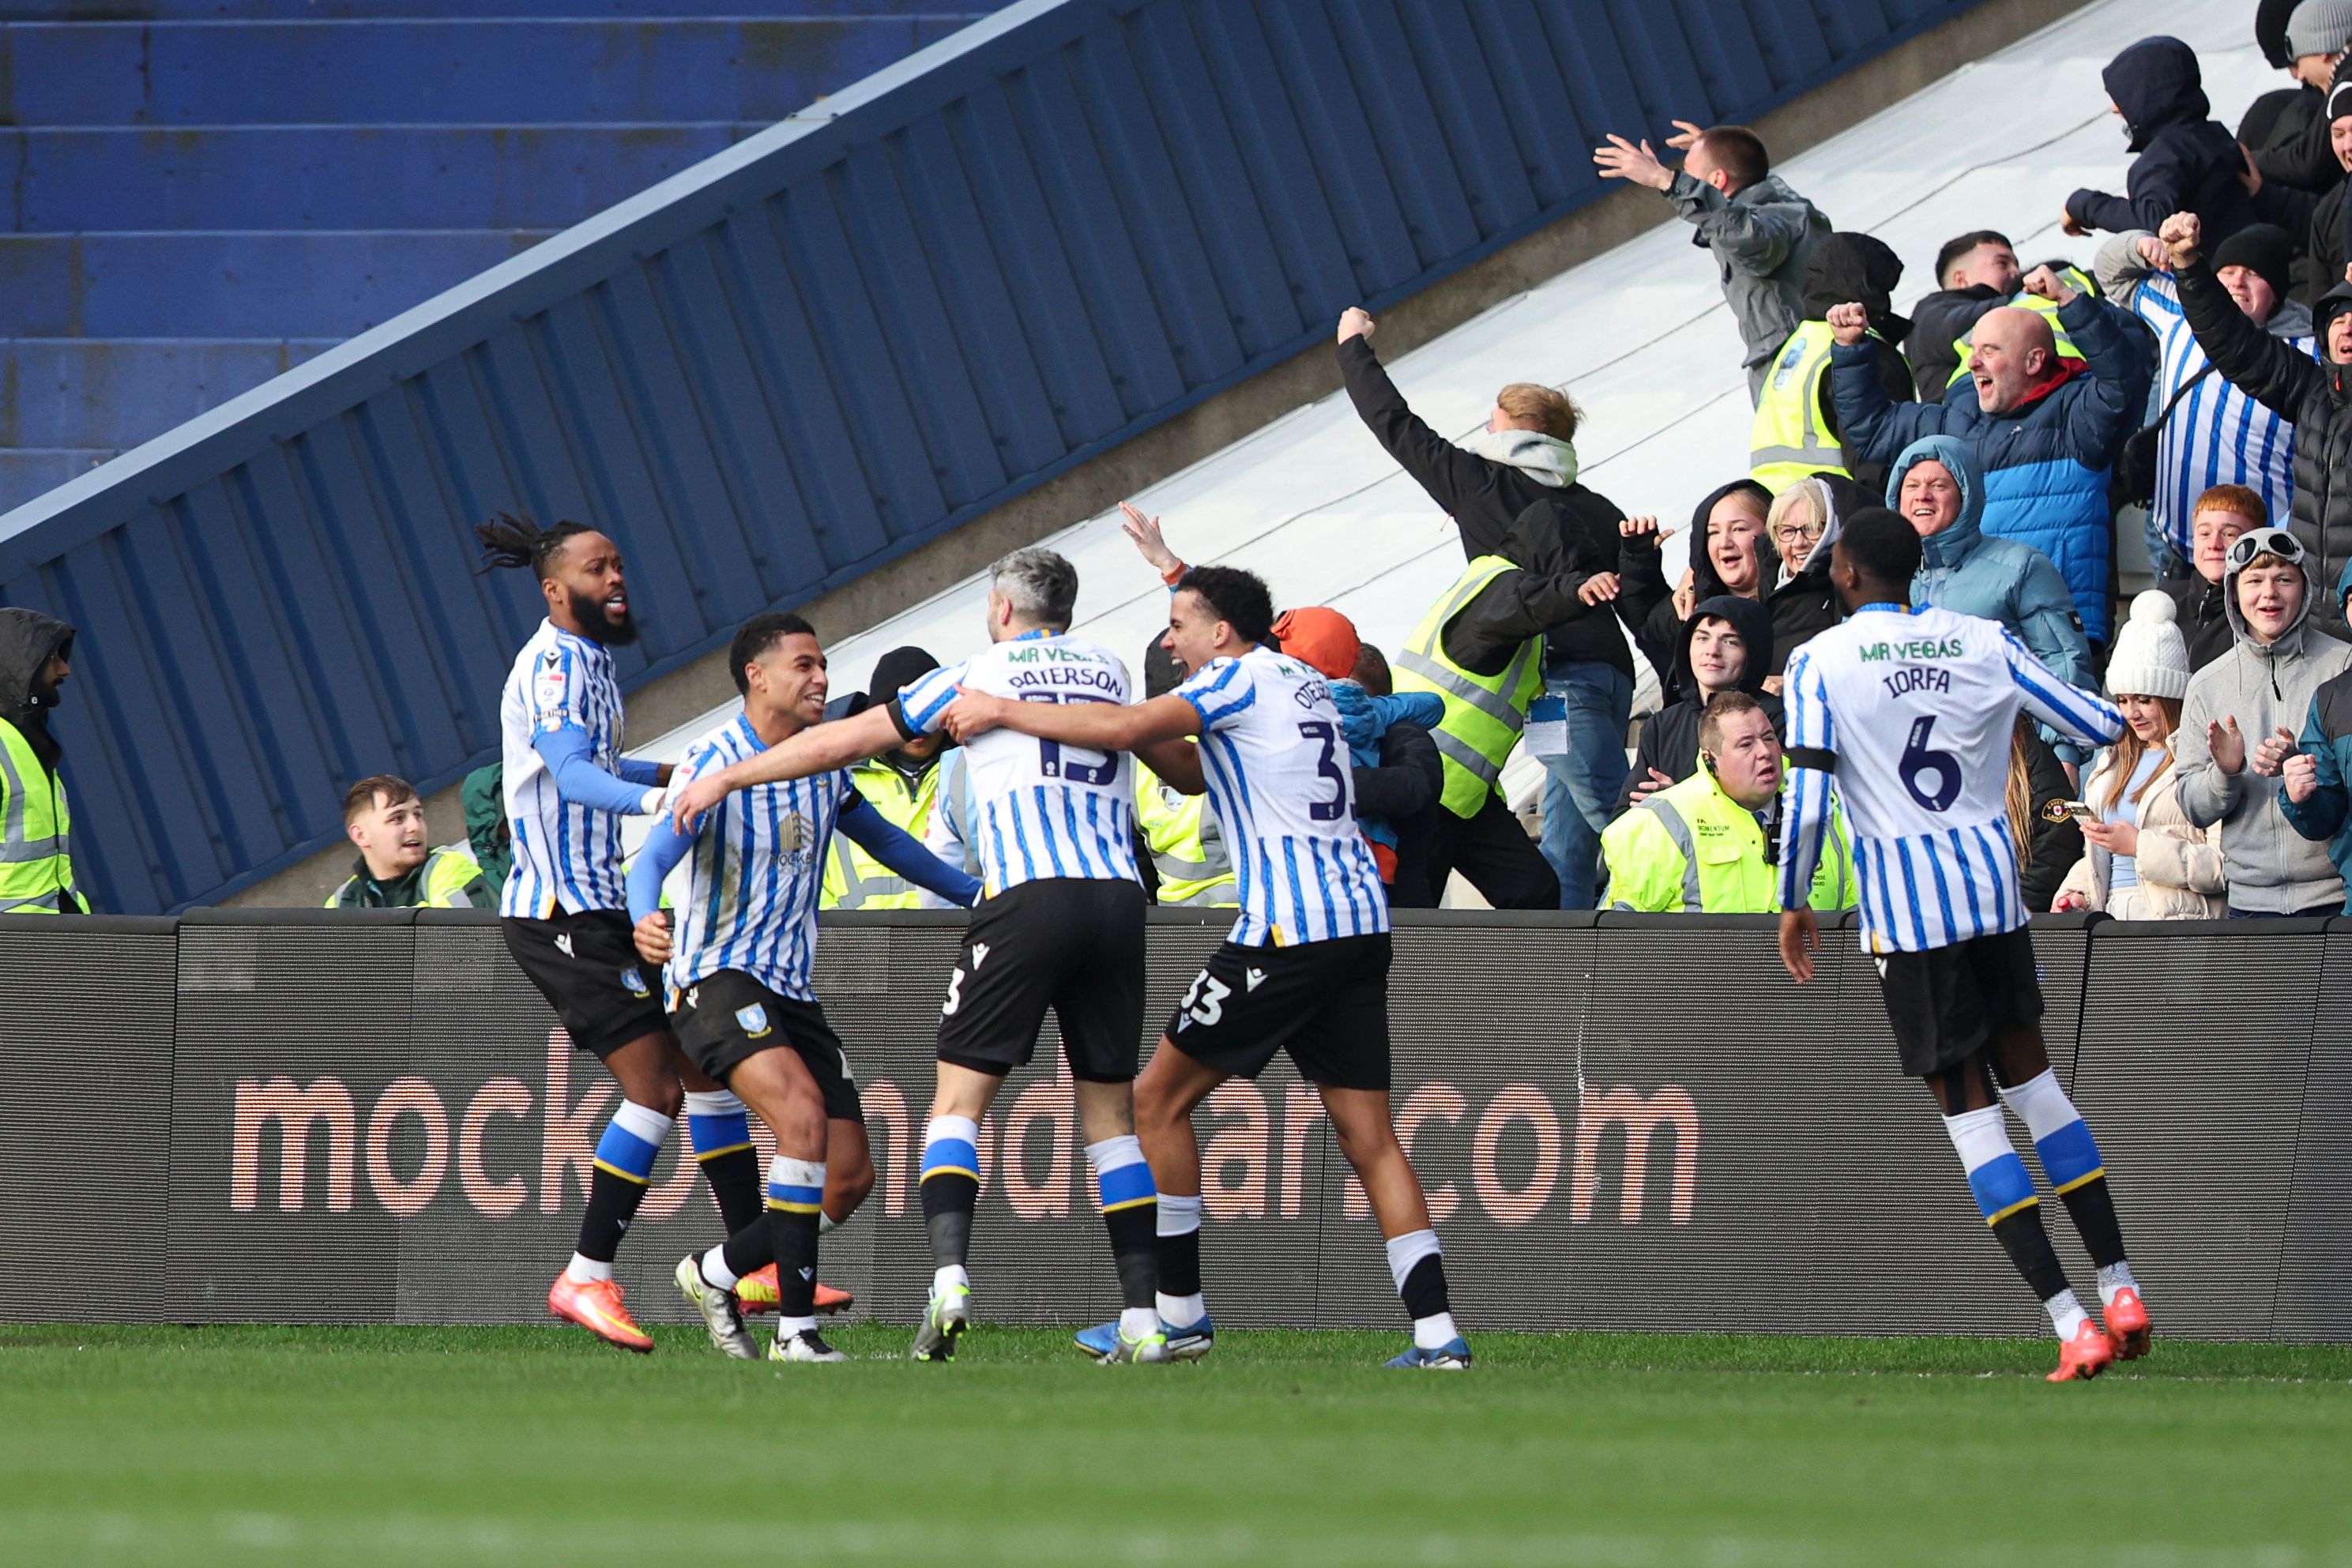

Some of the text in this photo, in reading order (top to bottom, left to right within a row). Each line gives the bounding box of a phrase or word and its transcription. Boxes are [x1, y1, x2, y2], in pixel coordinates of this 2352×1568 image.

[1859, 639, 1963, 662] MR VEGAS
[1008, 667, 1123, 698] PATERSON
[1882, 667, 1950, 699] IORFA
[1298, 721, 1356, 822] 3
[1899, 715, 1962, 812] 6
